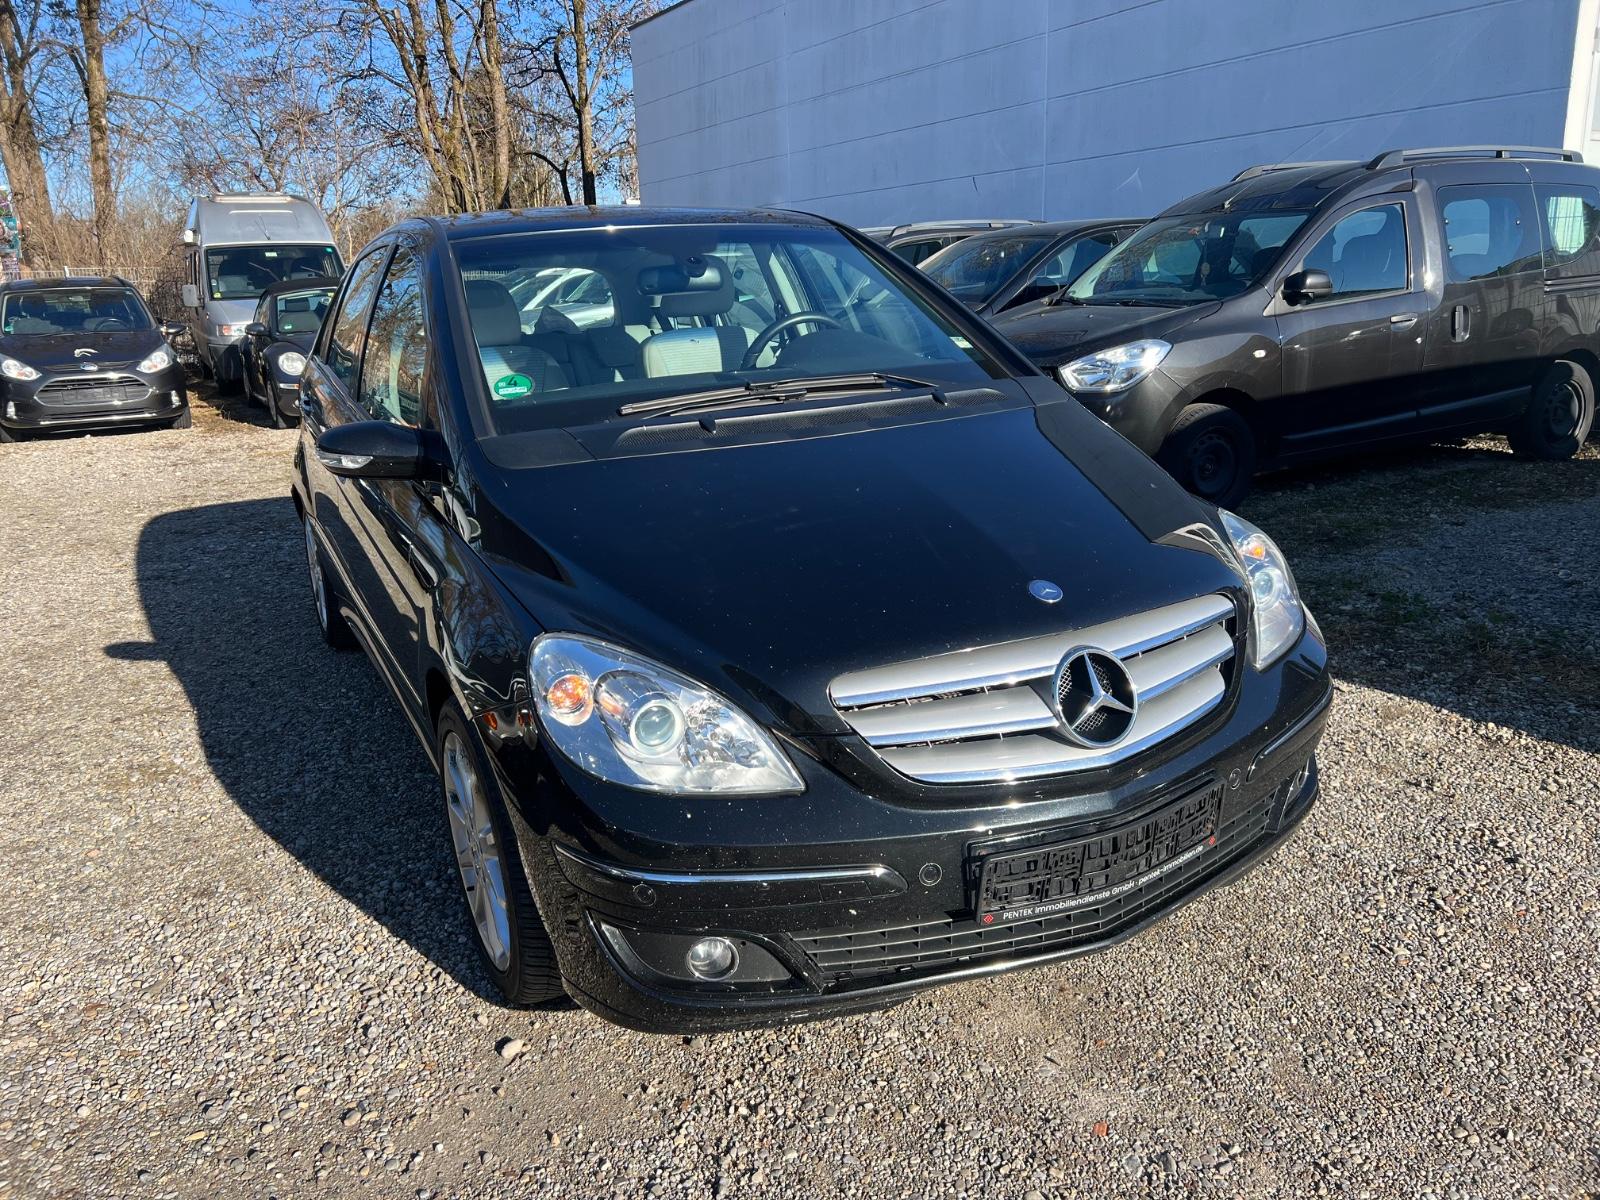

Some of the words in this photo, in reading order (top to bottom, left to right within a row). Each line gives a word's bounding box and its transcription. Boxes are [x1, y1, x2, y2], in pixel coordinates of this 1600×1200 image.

[507, 376, 518, 387] 4
[1003, 908, 1033, 920] PENTEK
[1111, 880, 1135, 895] GmbH
[1138, 845, 1204, 885] pentek-immobilien.de
